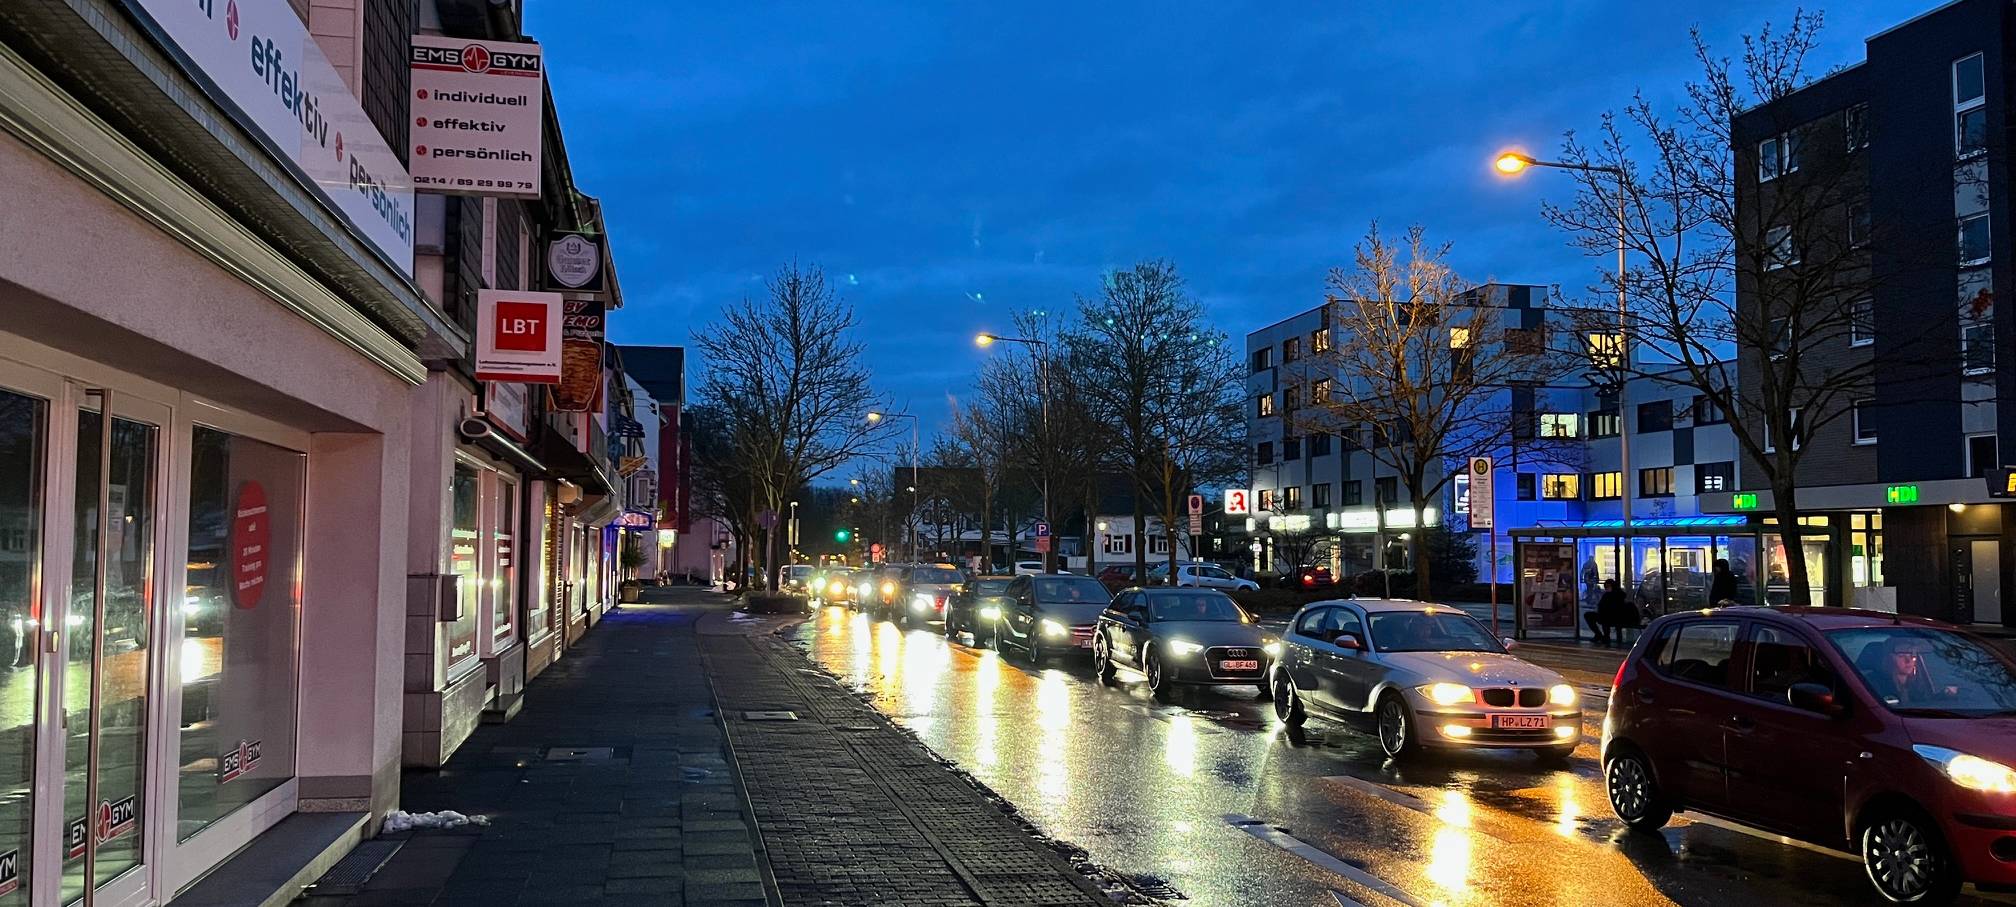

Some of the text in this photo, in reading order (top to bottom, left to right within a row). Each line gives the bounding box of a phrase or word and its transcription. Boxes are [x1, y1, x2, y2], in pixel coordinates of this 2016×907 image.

[413, 48, 538, 69] EMS GYM
[433, 89, 527, 106] individuell
[433, 118, 506, 132] effektiv
[252, 35, 411, 247] effektiv persönlich
[432, 147, 532, 162] persönlich
[413, 176, 446, 184] 0214
[457, 178, 473, 186] 89
[477, 179, 493, 187] 29
[497, 180, 513, 188] 99
[517, 181, 533, 189] 79
[502, 318, 540, 335] LBT
[562, 315, 600, 328] EMO
[1733, 493, 1757, 509] HDI
[1888, 485, 1917, 503] HDI
[1038, 524, 1047, 536] P
[224, 743, 261, 772] EMS GYM
[112, 799, 134, 825] GYM
